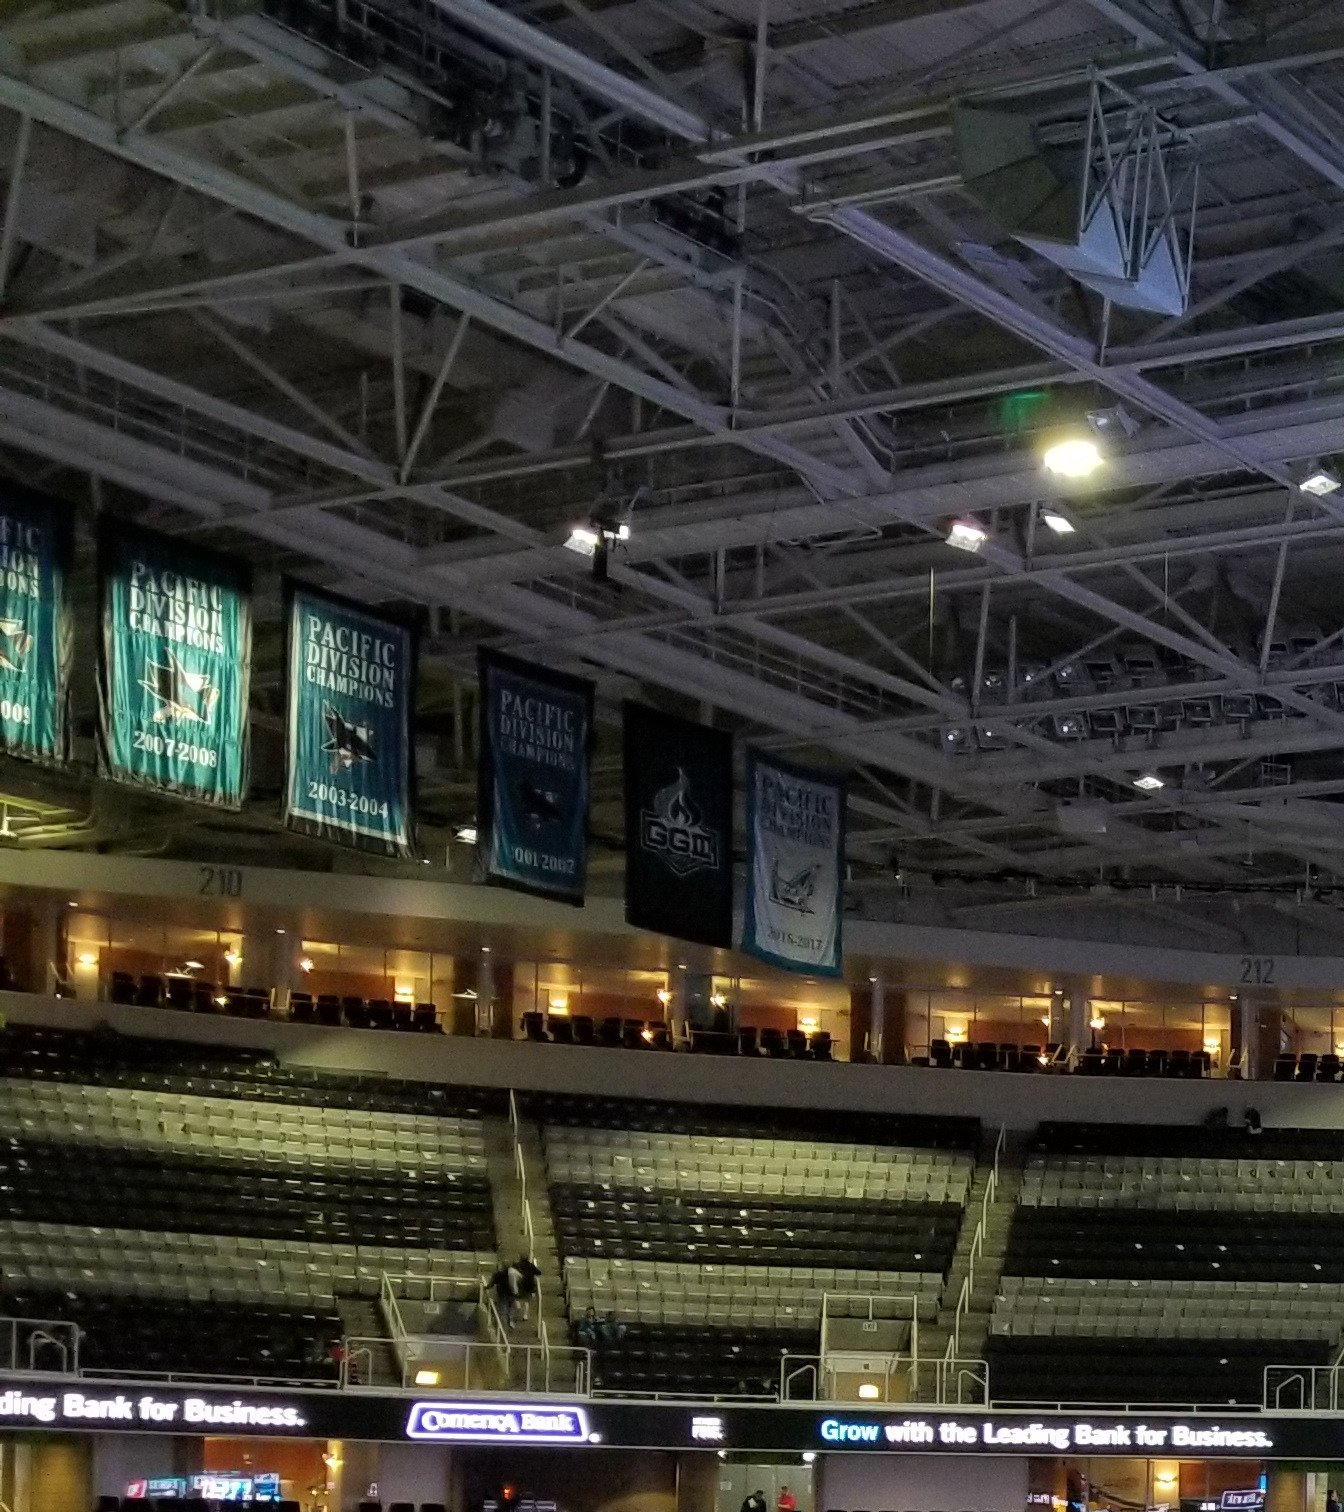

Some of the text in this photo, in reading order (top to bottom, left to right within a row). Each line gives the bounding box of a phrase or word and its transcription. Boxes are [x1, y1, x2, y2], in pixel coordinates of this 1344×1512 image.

[131, 561, 224, 611] PACIFIC
[129, 609, 225, 655] CHAMPIONS
[130, 585, 224, 637] DIVISION
[307, 614, 396, 669] PACIFIC
[305, 665, 395, 709] CHAMPIONS
[306, 641, 395, 693] DIVISION
[500, 689, 575, 733] PACIFIC
[132, 730, 218, 769] 2007-2008
[500, 714, 575, 754] DIVISION
[307, 780, 389, 819] 2003-2004
[200, 866, 243, 896] 210
[1240, 957, 1275, 984] 212
[63, 1392, 133, 1420] Bank
[138, 1396, 179, 1421] for
[184, 1397, 307, 1427] Business.
[821, 1419, 1274, 1449] Grow with the Leading Bank for Business.
